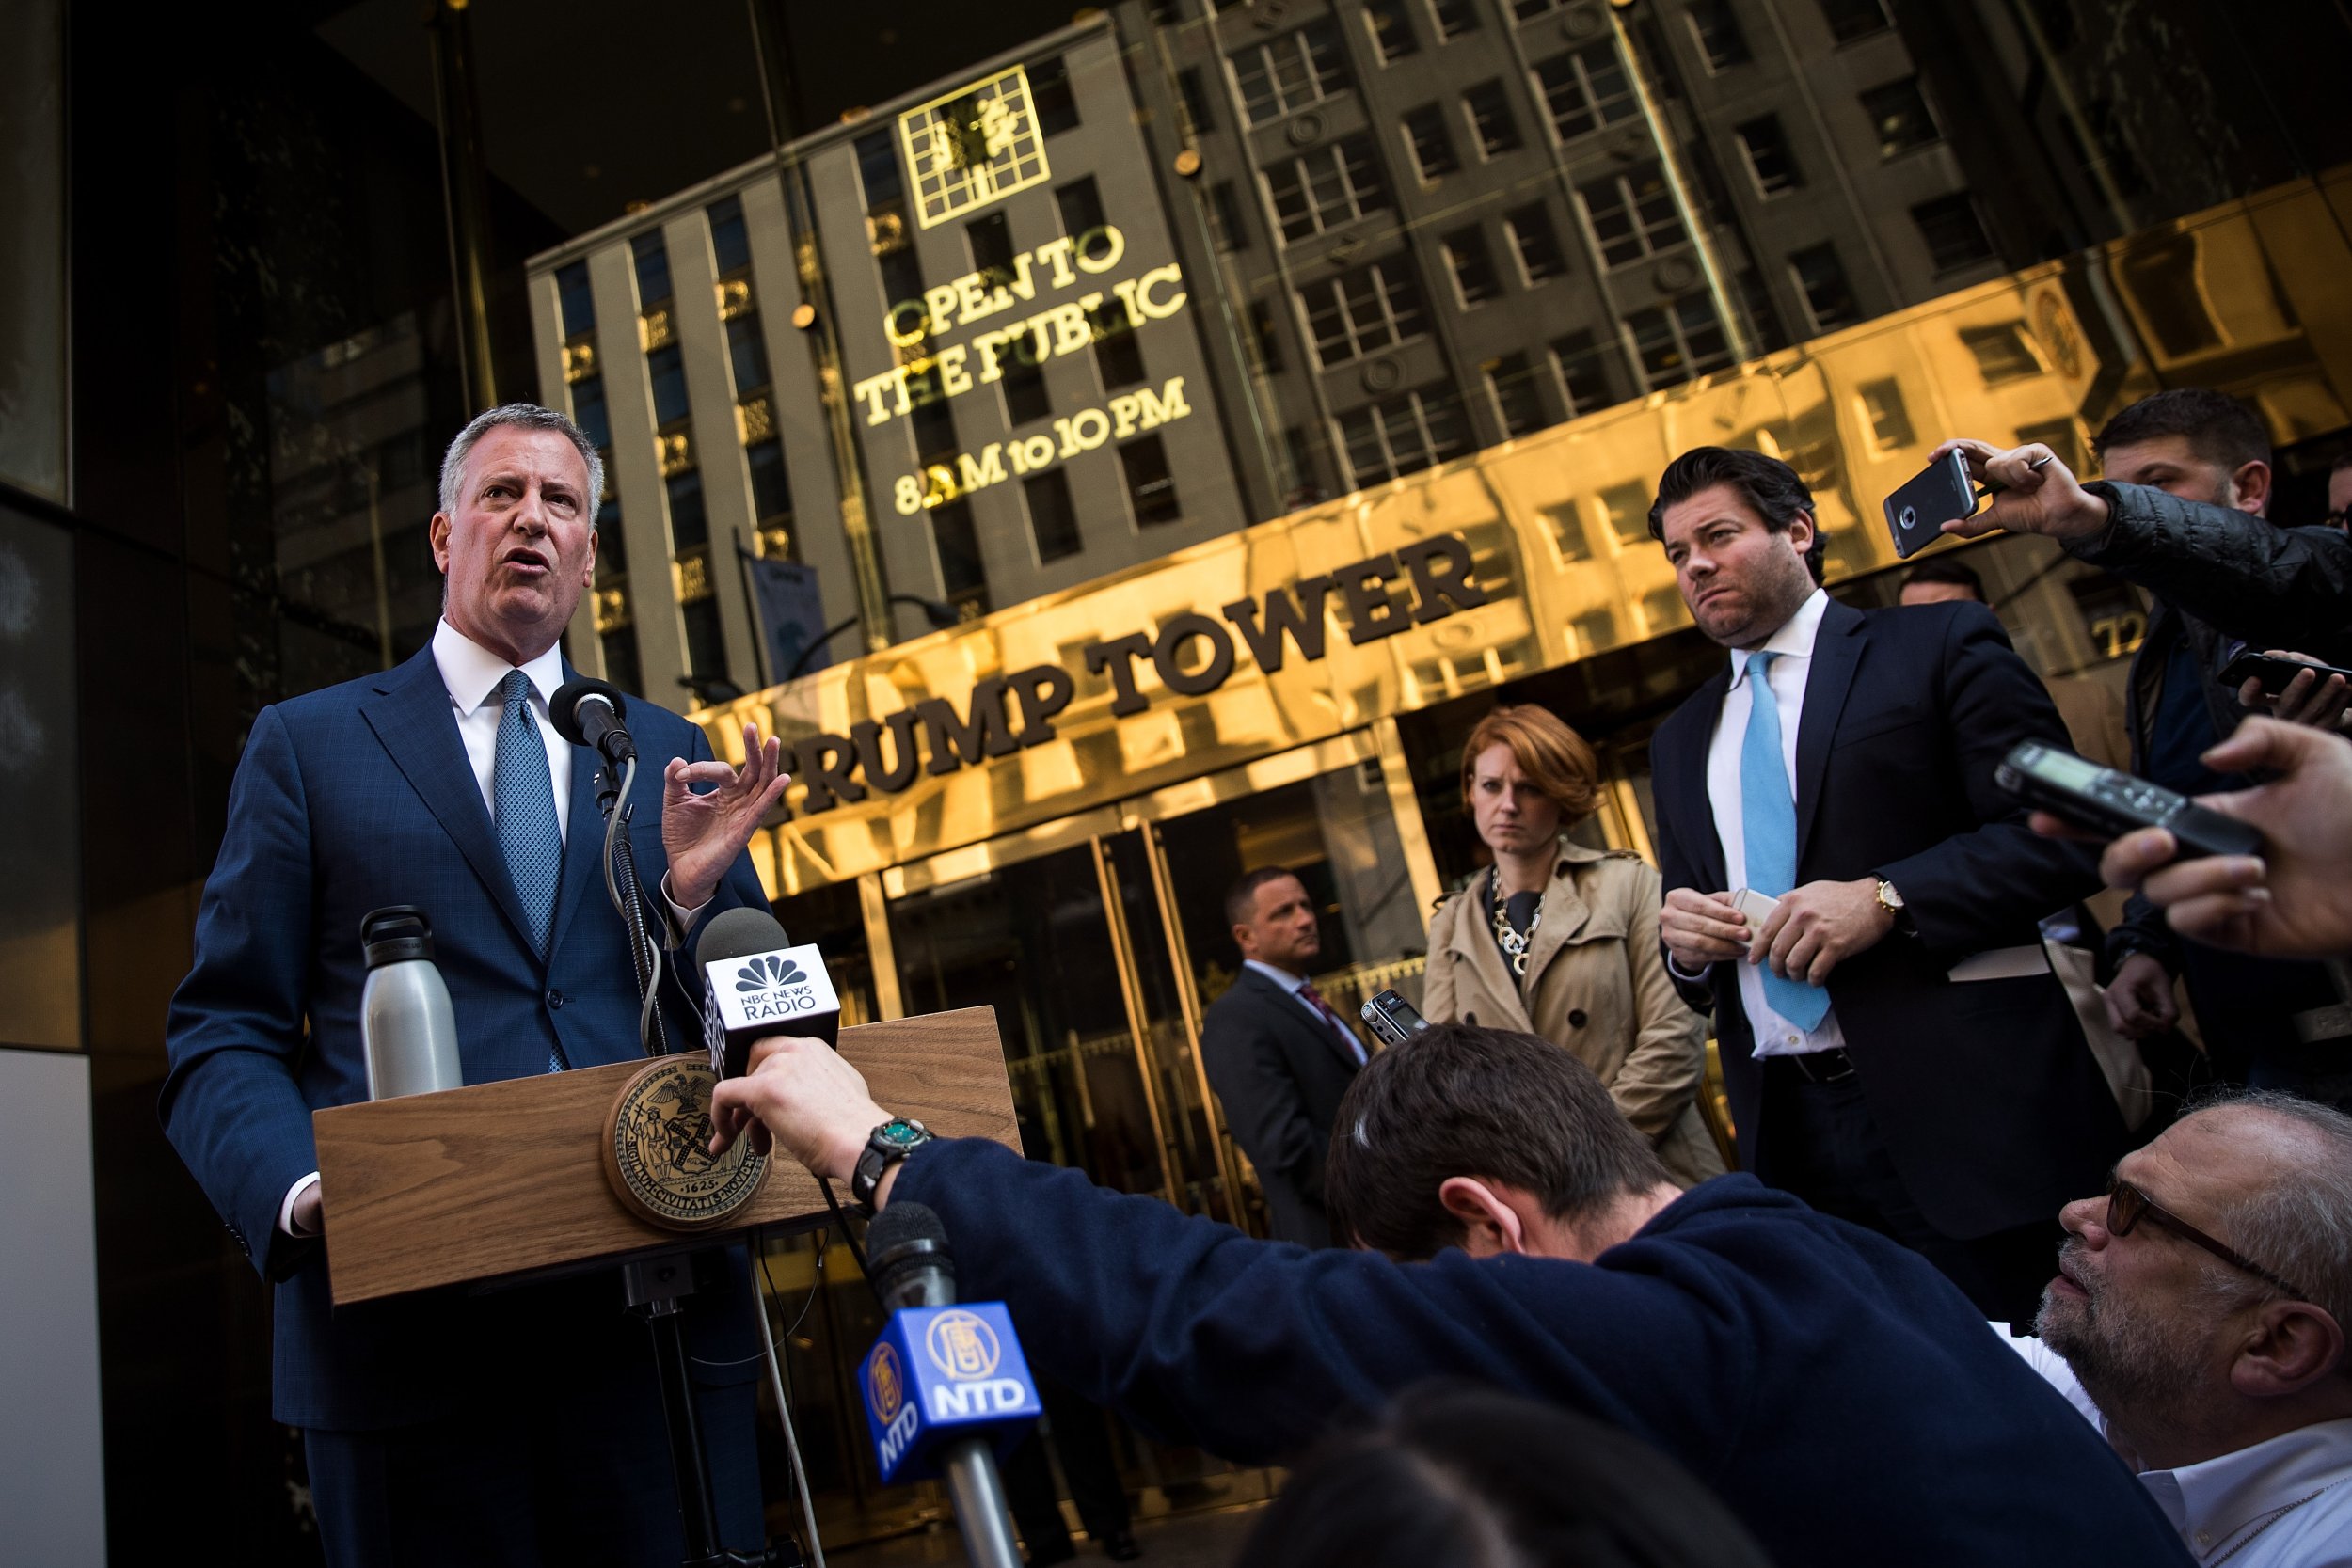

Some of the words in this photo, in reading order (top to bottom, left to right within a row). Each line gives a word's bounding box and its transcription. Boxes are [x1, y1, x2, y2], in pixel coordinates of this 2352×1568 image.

[884, 251, 1033, 347] OPEN
[1037, 225, 1125, 289] TO
[853, 344, 973, 426] THE
[973, 262, 1187, 383] PUBLIC
[1007, 434, 1055, 476] to
[1084, 531, 1488, 719] TOWER
[741, 993, 771, 1006] NBC
[773, 985, 813, 1001] NEWS
[743, 995, 816, 1021] RADIO
[933, 1377, 1025, 1417] NTD
[879, 1401, 919, 1471] NTD
